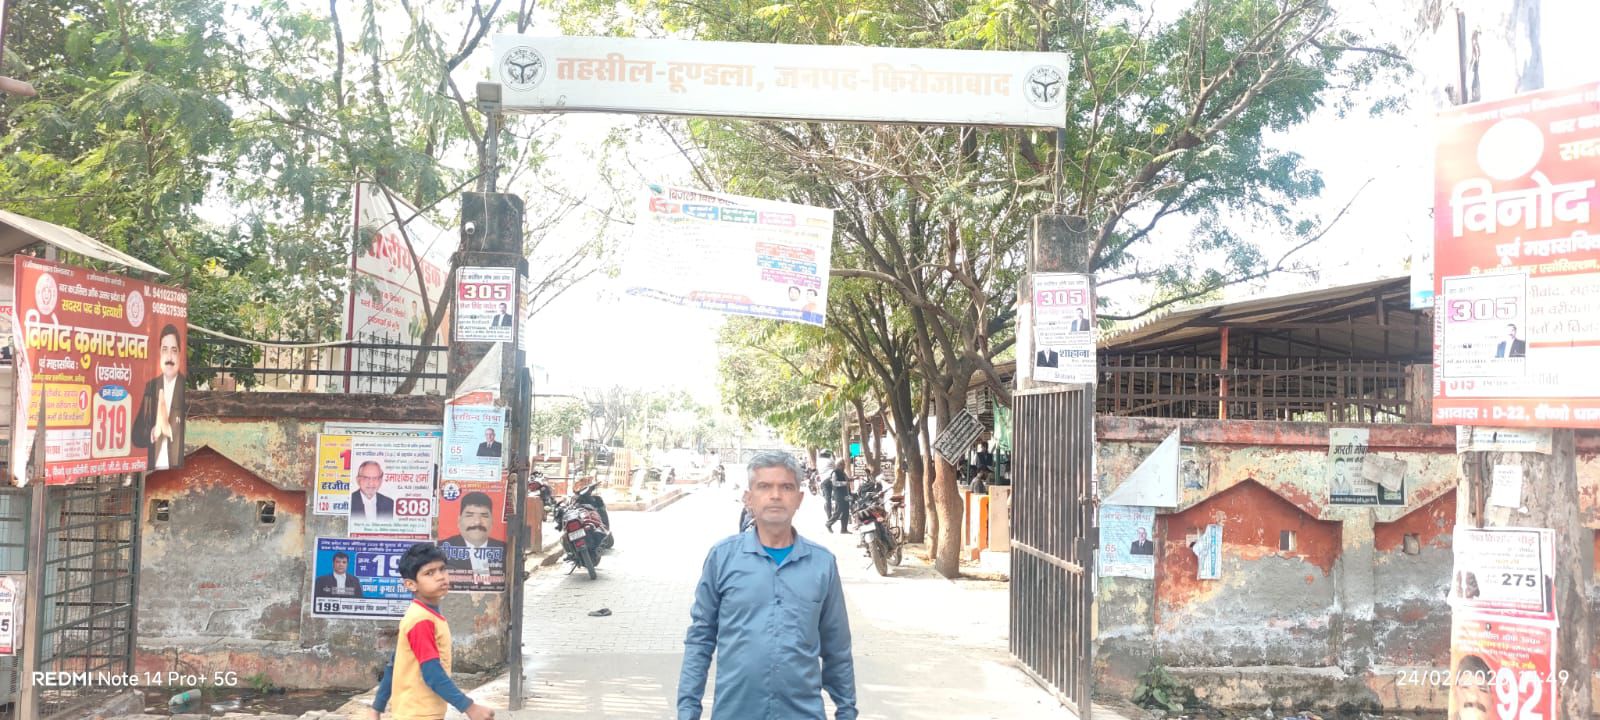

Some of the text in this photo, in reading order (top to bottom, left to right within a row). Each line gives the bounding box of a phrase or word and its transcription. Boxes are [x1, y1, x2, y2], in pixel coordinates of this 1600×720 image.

[1449, 170, 1596, 237] विनोद
[463, 284, 508, 299] 305
[1041, 289, 1083, 307] 305
[62, 299, 123, 319] सदस्य पद के प्रत्याशी
[1451, 297, 1518, 322] 305
[24, 308, 150, 369] विनोद कुमार रावत
[95, 362, 133, 386] (एडवोकेट)
[1436, 405, 1479, 419] आवास
[1492, 405, 1531, 421] D-22,
[96, 403, 127, 451] 319
[450, 446, 462, 454] 65
[1333, 442, 1353, 456] आरती
[340, 449, 351, 470] 1
[384, 470, 430, 483] उमाशंकर शर्मा
[320, 480, 350, 491] हरजीत
[333, 500, 349, 511] हरजी
[397, 499, 429, 515] 308
[473, 546, 504, 563] यादव
[1104, 544, 1117, 553] 65
[372, 554, 402, 577] 19
[1501, 571, 1537, 588] 275
[379, 584, 395, 594] कुमार
[317, 602, 340, 612] 199
[1495, 666, 1544, 720] 92
